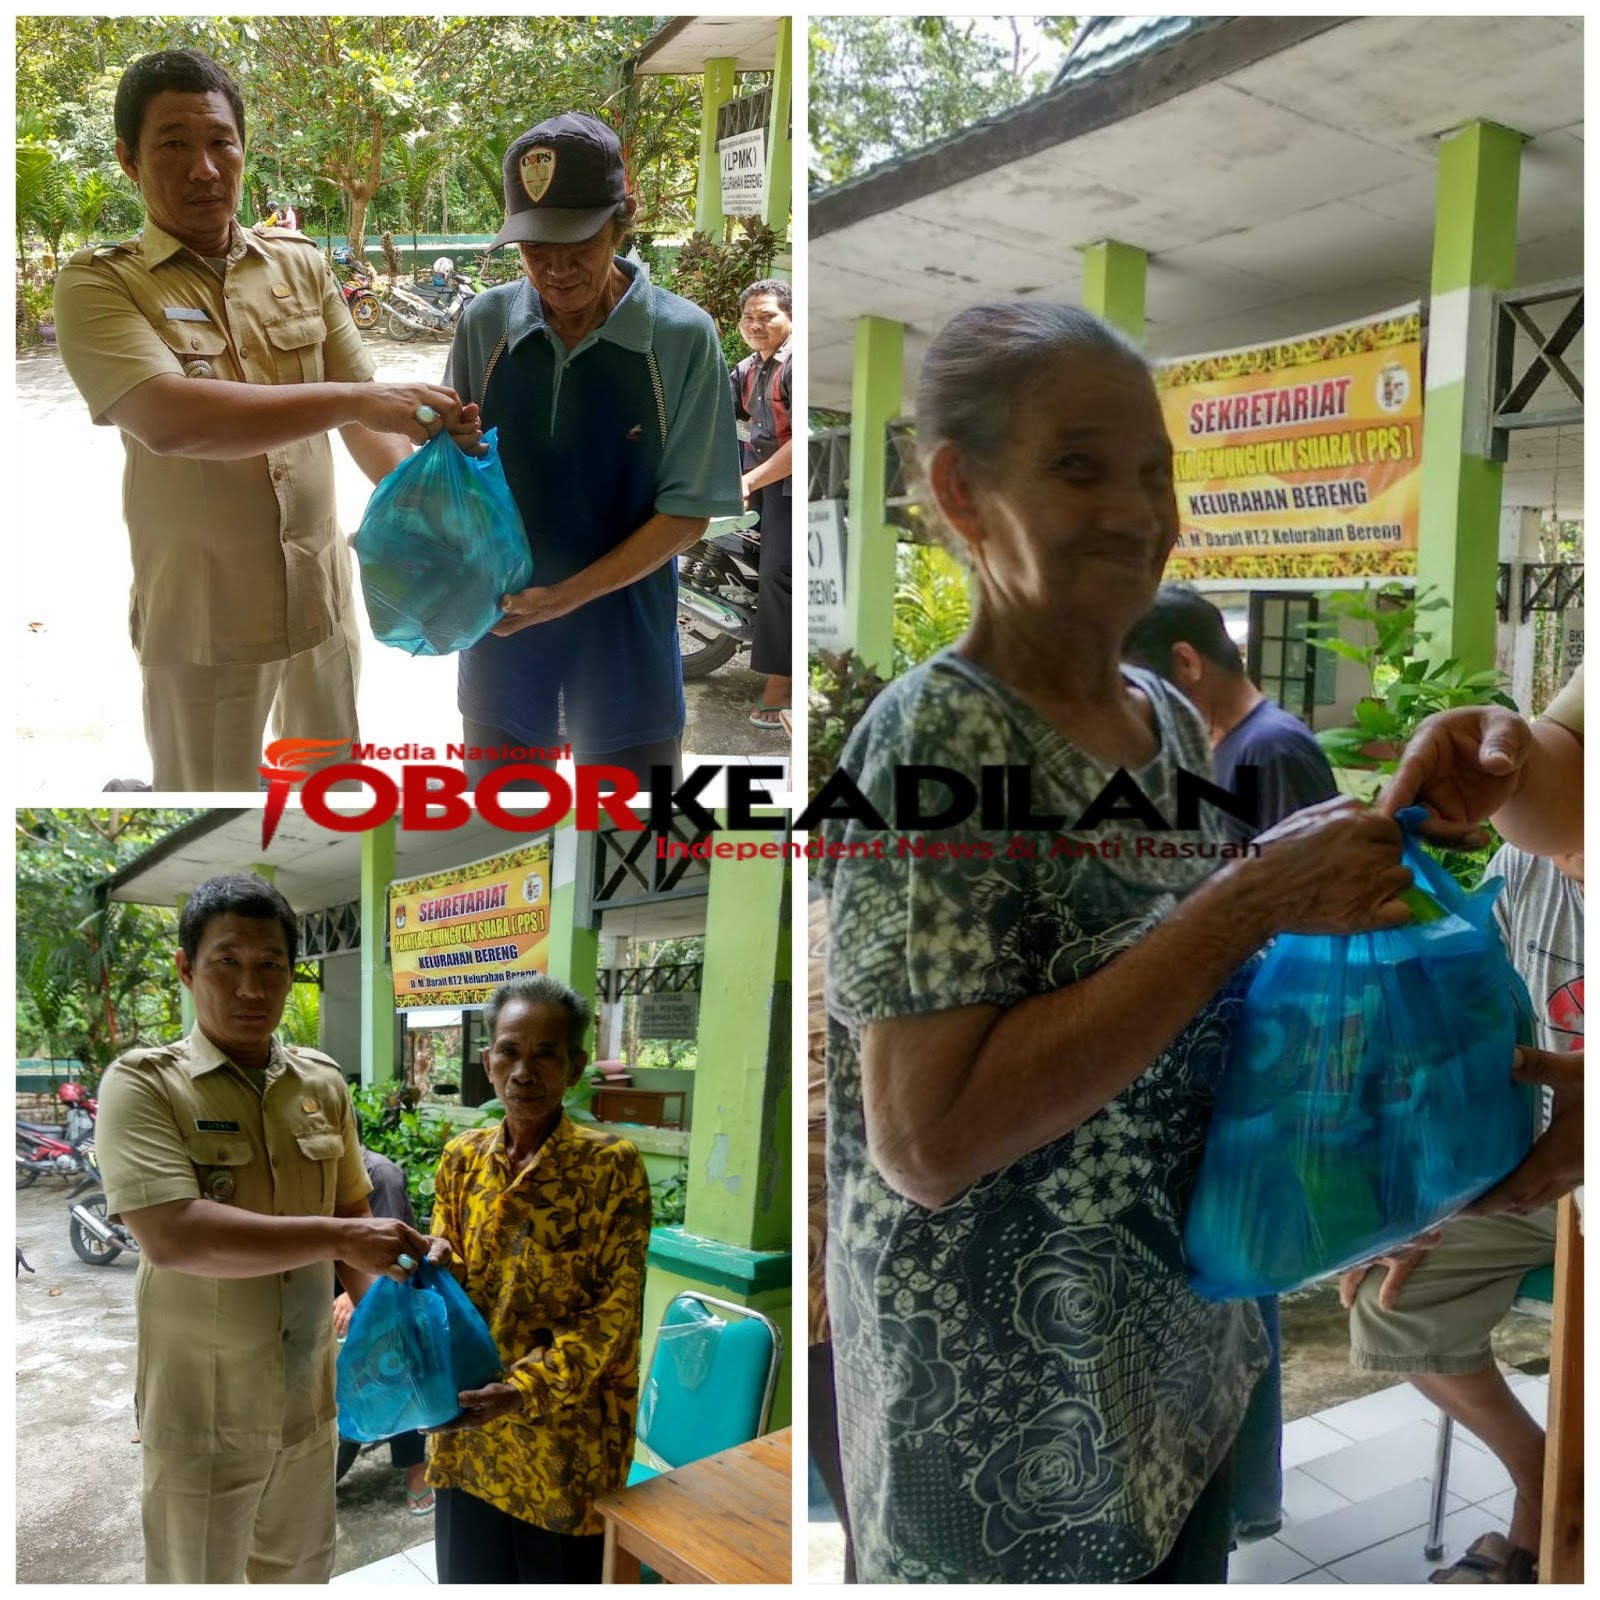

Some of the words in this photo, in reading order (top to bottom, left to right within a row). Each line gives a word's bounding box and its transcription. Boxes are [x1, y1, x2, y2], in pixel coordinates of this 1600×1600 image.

[522, 152, 552, 166] COPS
[724, 146, 757, 172] (LPMK)
[1190, 378, 1351, 435] SEKRETARIAT
[1297, 431, 1355, 470] SUARA
[1188, 488, 1288, 516] KELURAHAN
[1292, 480, 1368, 508] BERENG
[1271, 526, 1344, 544] Kelurahan
[1346, 524, 1402, 541] Bereng
[419, 884, 508, 922] SEKRETARIAT
[478, 915, 511, 941] SUARA
[418, 950, 474, 970] KELURAHAN
[475, 944, 519, 963] BERENG
[463, 972, 504, 984] Kelurahan
